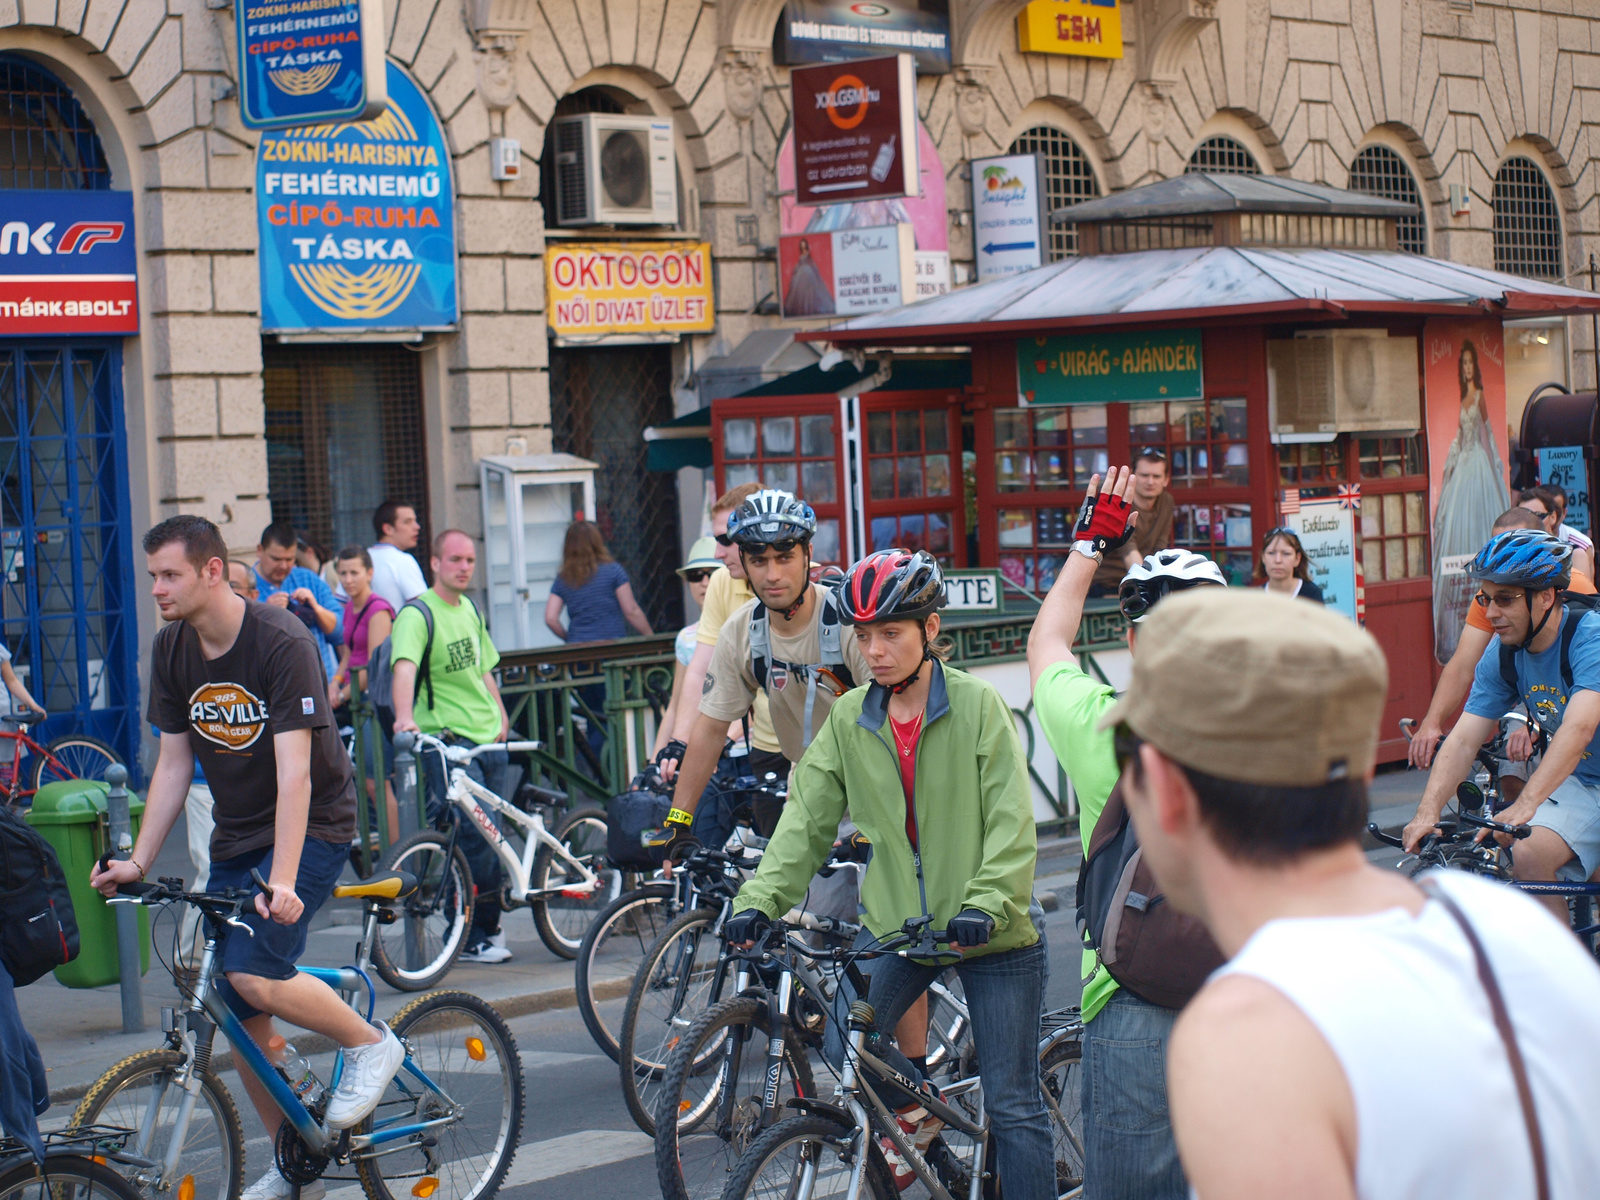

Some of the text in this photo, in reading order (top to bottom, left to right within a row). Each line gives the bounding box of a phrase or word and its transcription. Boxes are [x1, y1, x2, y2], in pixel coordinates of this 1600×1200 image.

[248, 9, 358, 36] FEHÉRNEMŰ
[859, 25, 869, 43] ÉS
[1055, 13, 1102, 44] GSM
[265, 48, 343, 68] TÁSKA
[263, 140, 439, 166] ZOKNI-HARISNYA
[265, 169, 440, 197] FEHÉRNEMŰ
[292, 234, 414, 260] TÁSKA
[554, 254, 704, 288] OKTOGON
[557, 298, 590, 324] NŐI
[596, 301, 644, 323] DIVAT
[1059, 339, 1197, 376] VIRÁG AJÁNDÉK
[214, 692, 237, 703] 985
[189, 701, 269, 724] ASVILLE
[230, 727, 252, 737] GEAR
[1520, 884, 1586, 892] woodlands
[894, 1072, 921, 1095] ALFA
